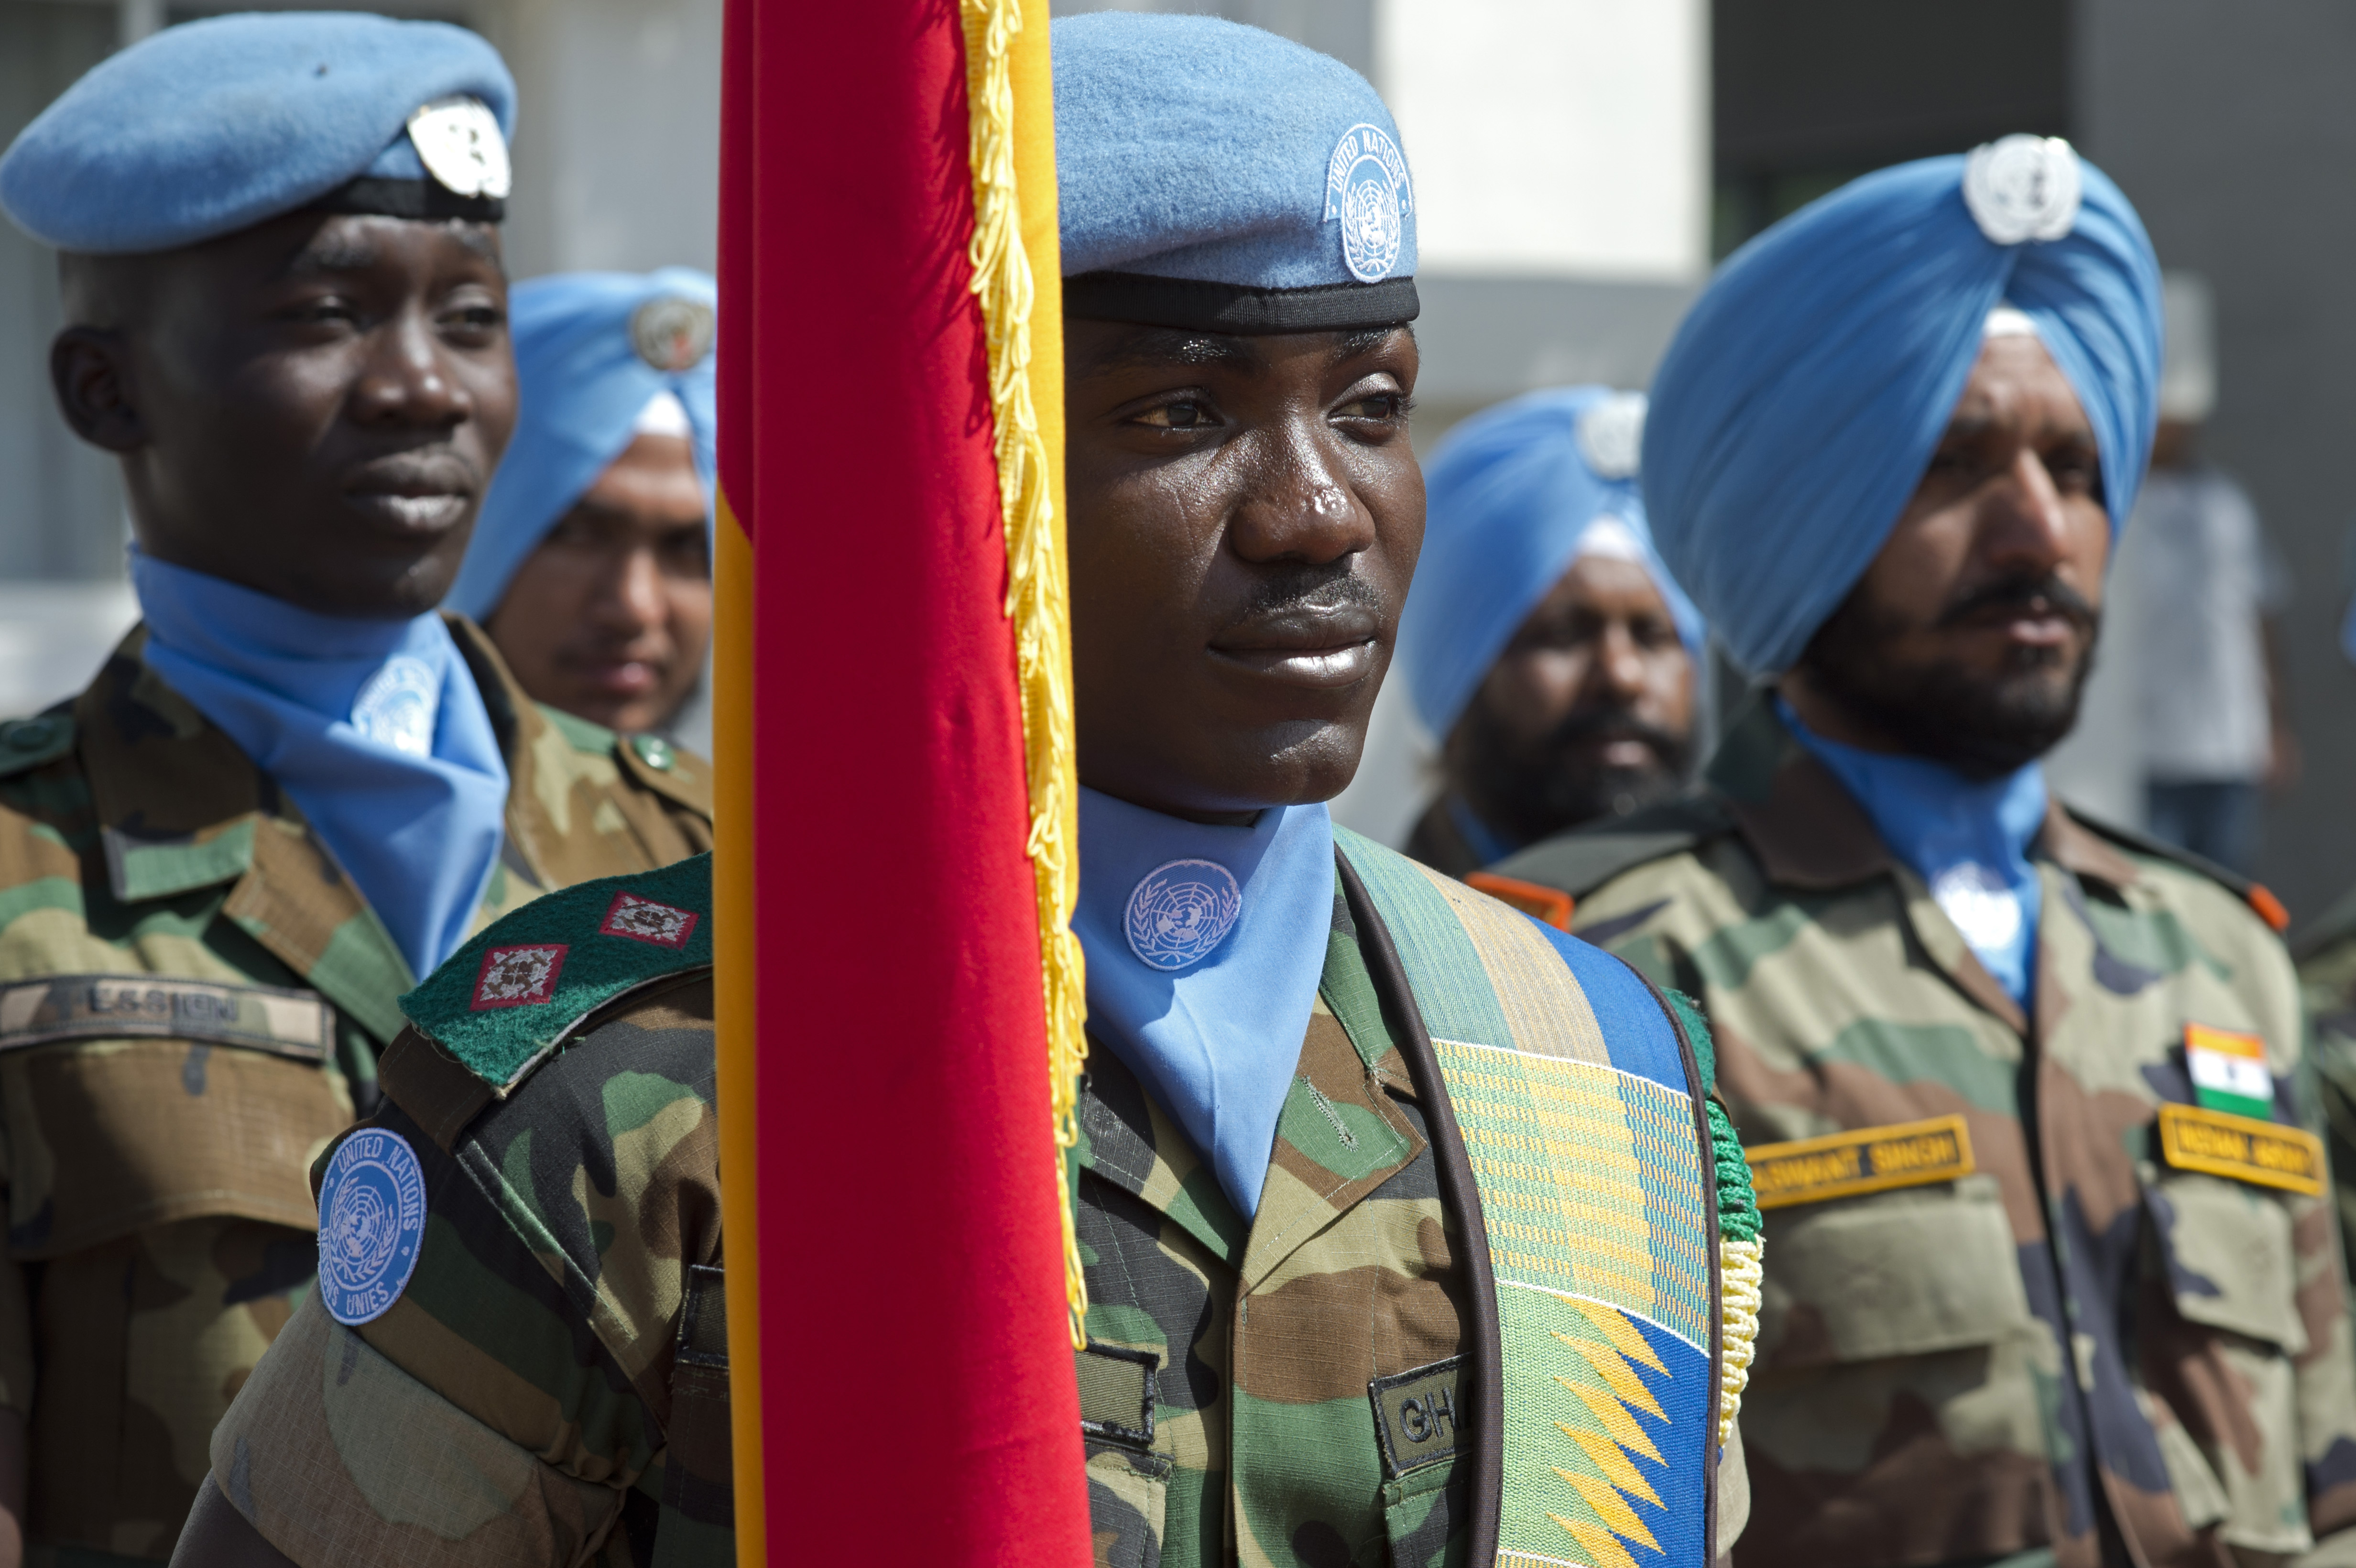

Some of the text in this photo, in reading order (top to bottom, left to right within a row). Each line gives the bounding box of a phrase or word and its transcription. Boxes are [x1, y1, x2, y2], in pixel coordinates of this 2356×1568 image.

[1331, 131, 1404, 193] UNITED NATIONS
[338, 1136, 418, 1230] UNITED NATIONS
[321, 1227, 389, 1316] NATIONS UNIES
